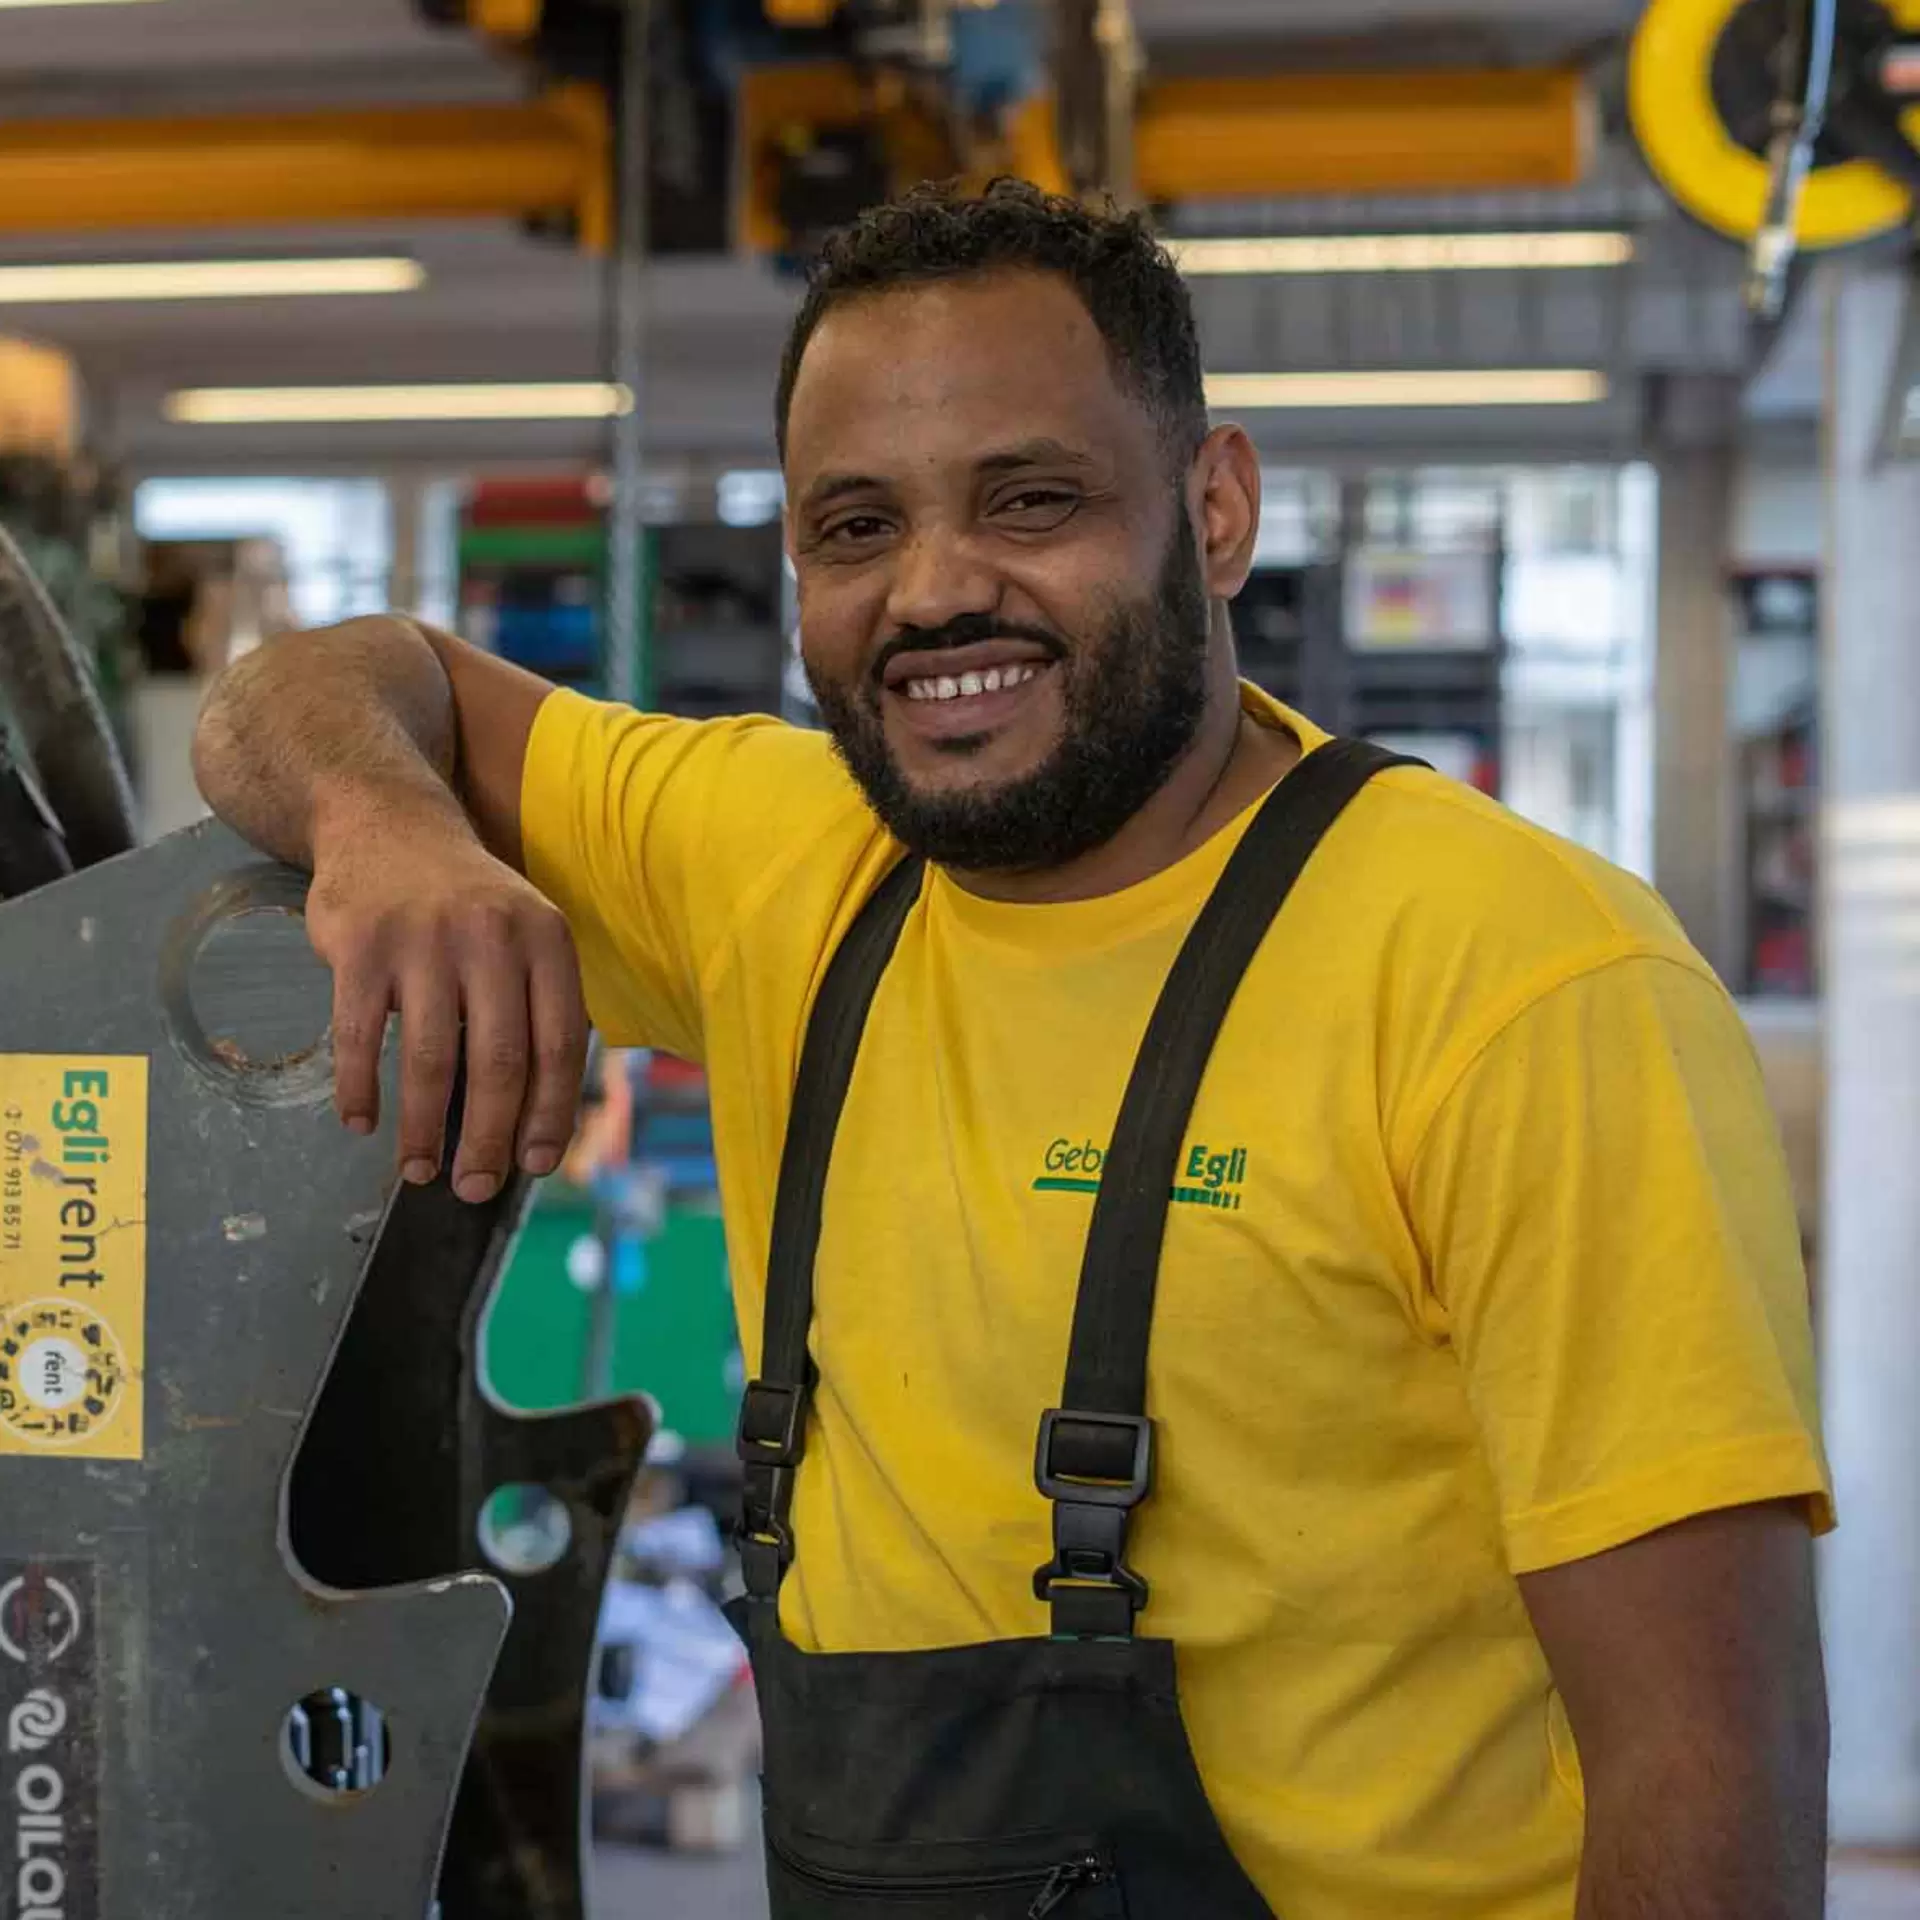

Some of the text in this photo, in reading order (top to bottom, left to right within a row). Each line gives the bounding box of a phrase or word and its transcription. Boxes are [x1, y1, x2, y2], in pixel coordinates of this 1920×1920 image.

[52, 1070, 109, 1288] Egli rent
[1045, 1138, 1248, 1188] Geb Egli
